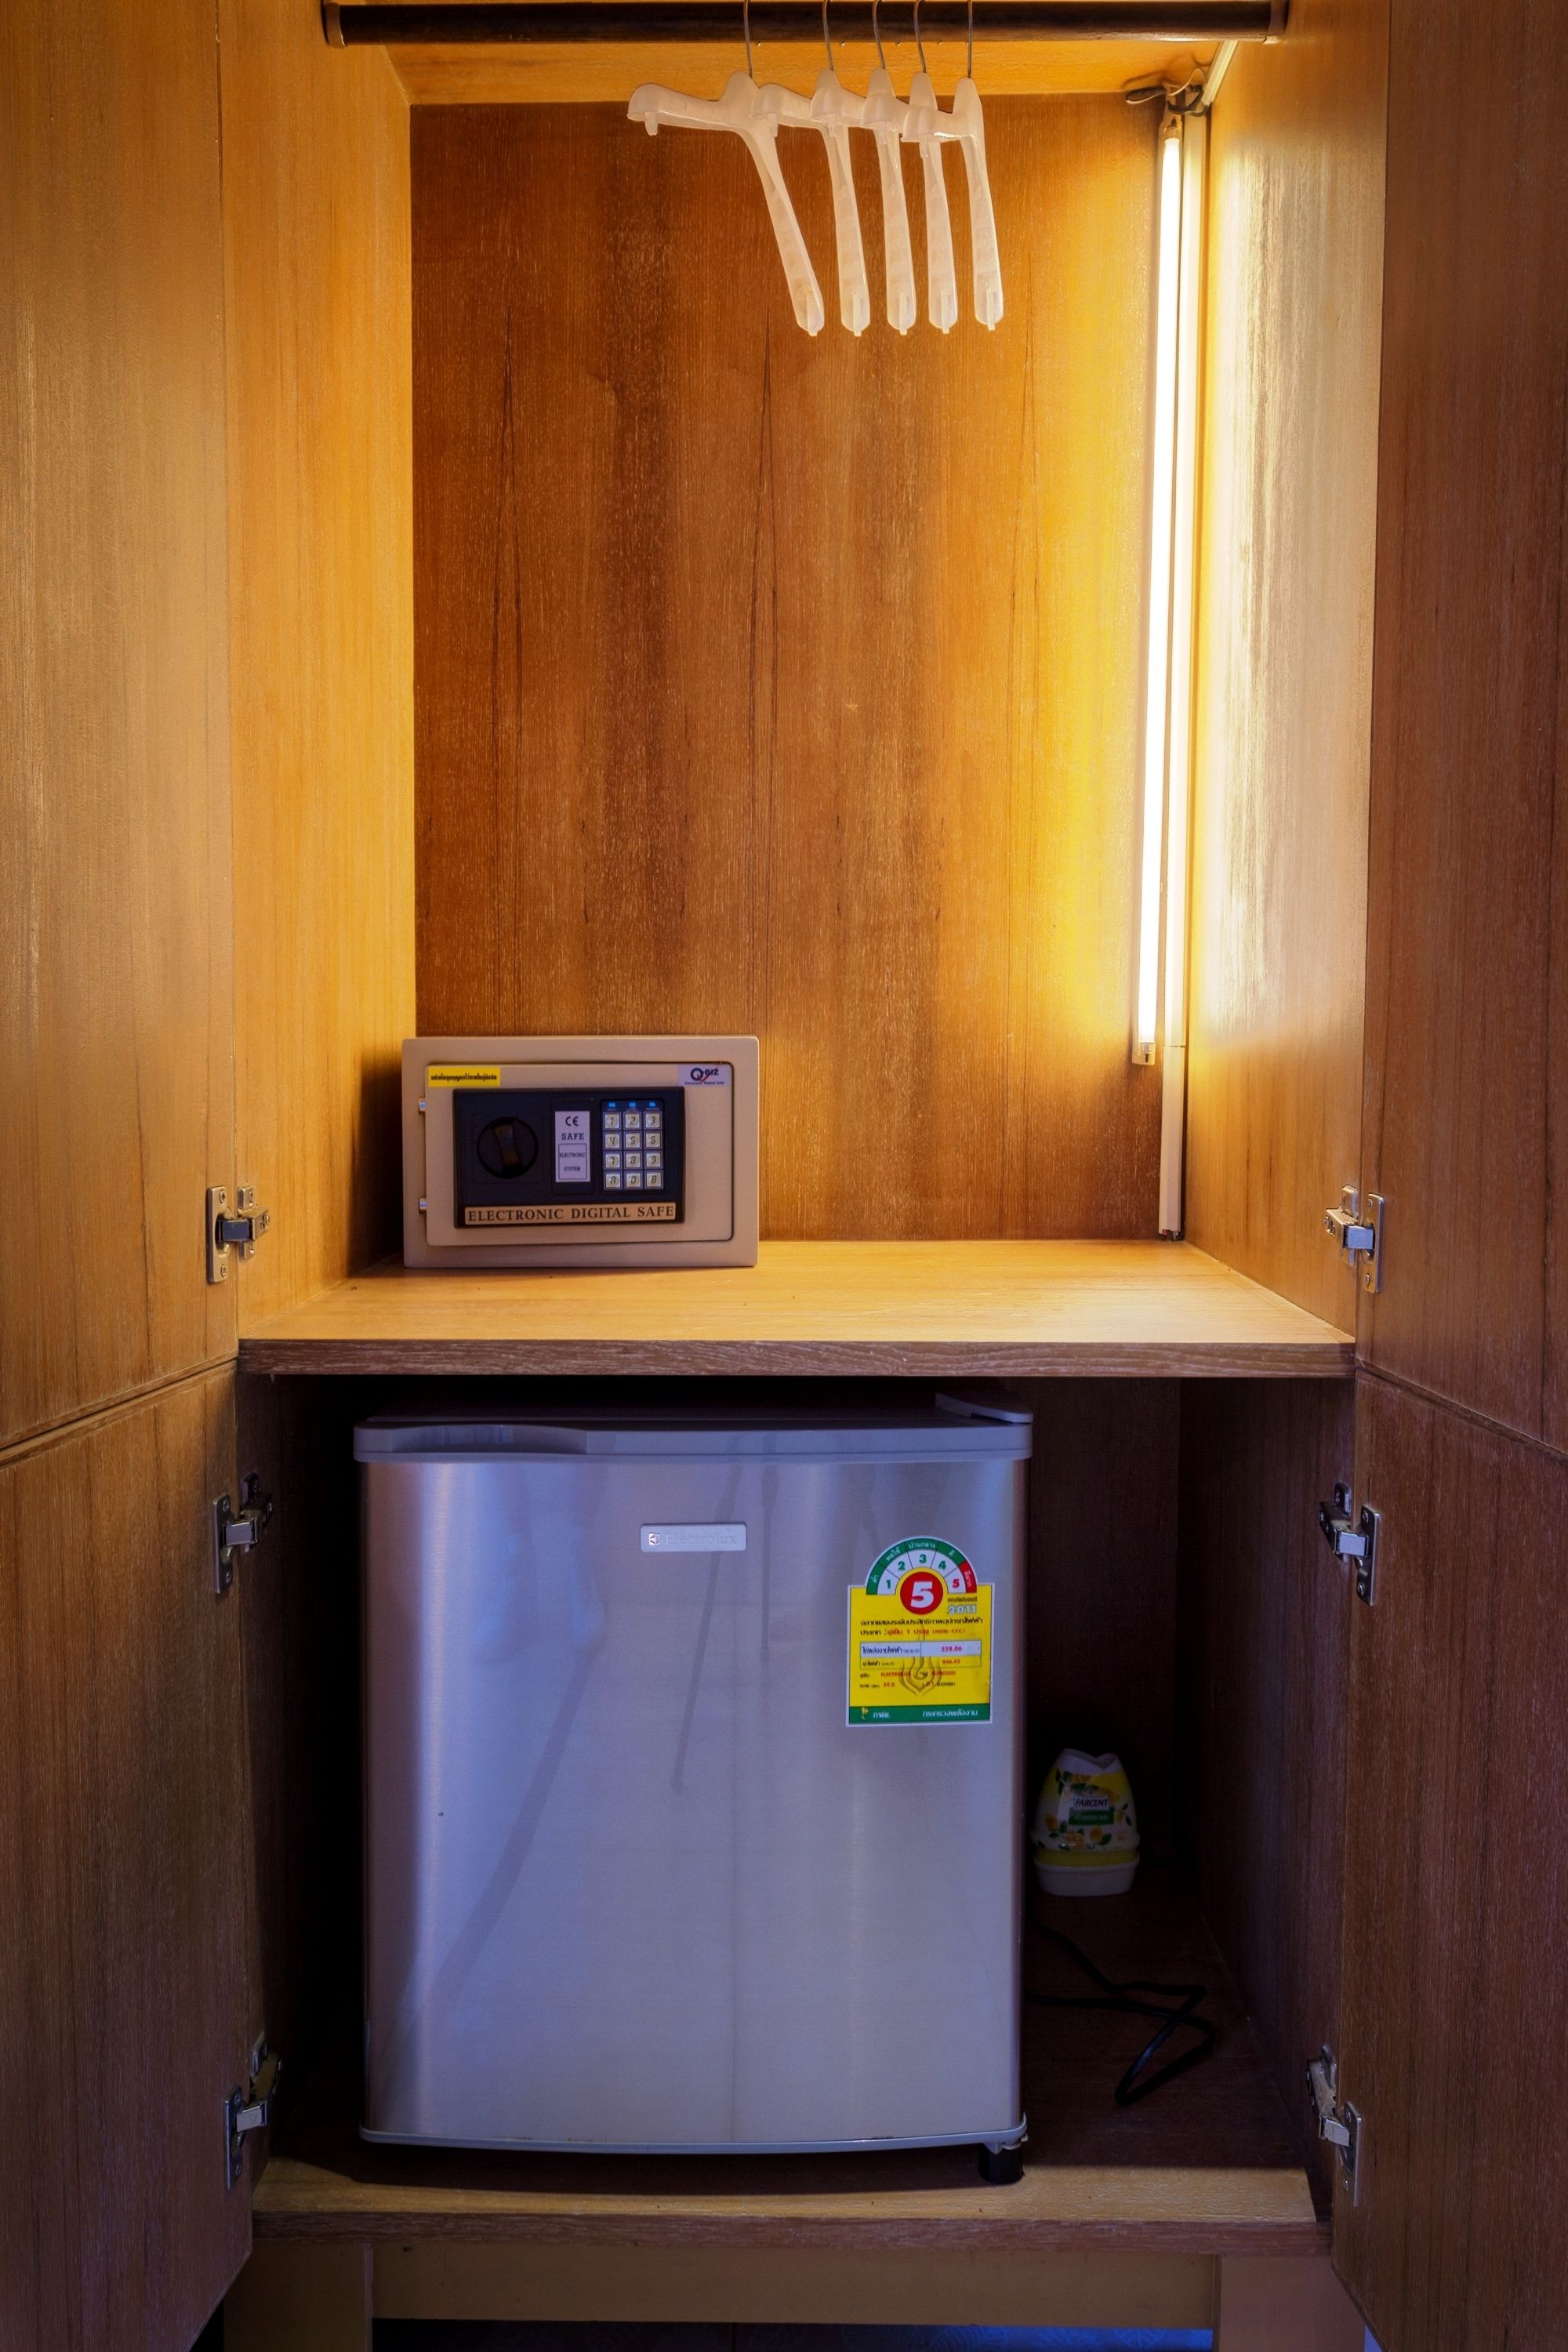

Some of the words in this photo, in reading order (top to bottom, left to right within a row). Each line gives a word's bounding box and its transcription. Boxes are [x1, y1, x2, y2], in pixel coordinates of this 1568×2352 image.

[468, 1207, 564, 1221] ELECTRONIC
[572, 1206, 630, 1219] DIGITAL
[637, 1205, 674, 1218] SAFE
[886, 1580, 891, 1589] 1
[898, 1561, 906, 1571] 2
[919, 1554, 927, 1563] 3
[938, 1560, 947, 1570] 4
[952, 1579, 960, 1588] 5
[910, 1581, 935, 1608] 5
[947, 1604, 978, 1614] 2011
